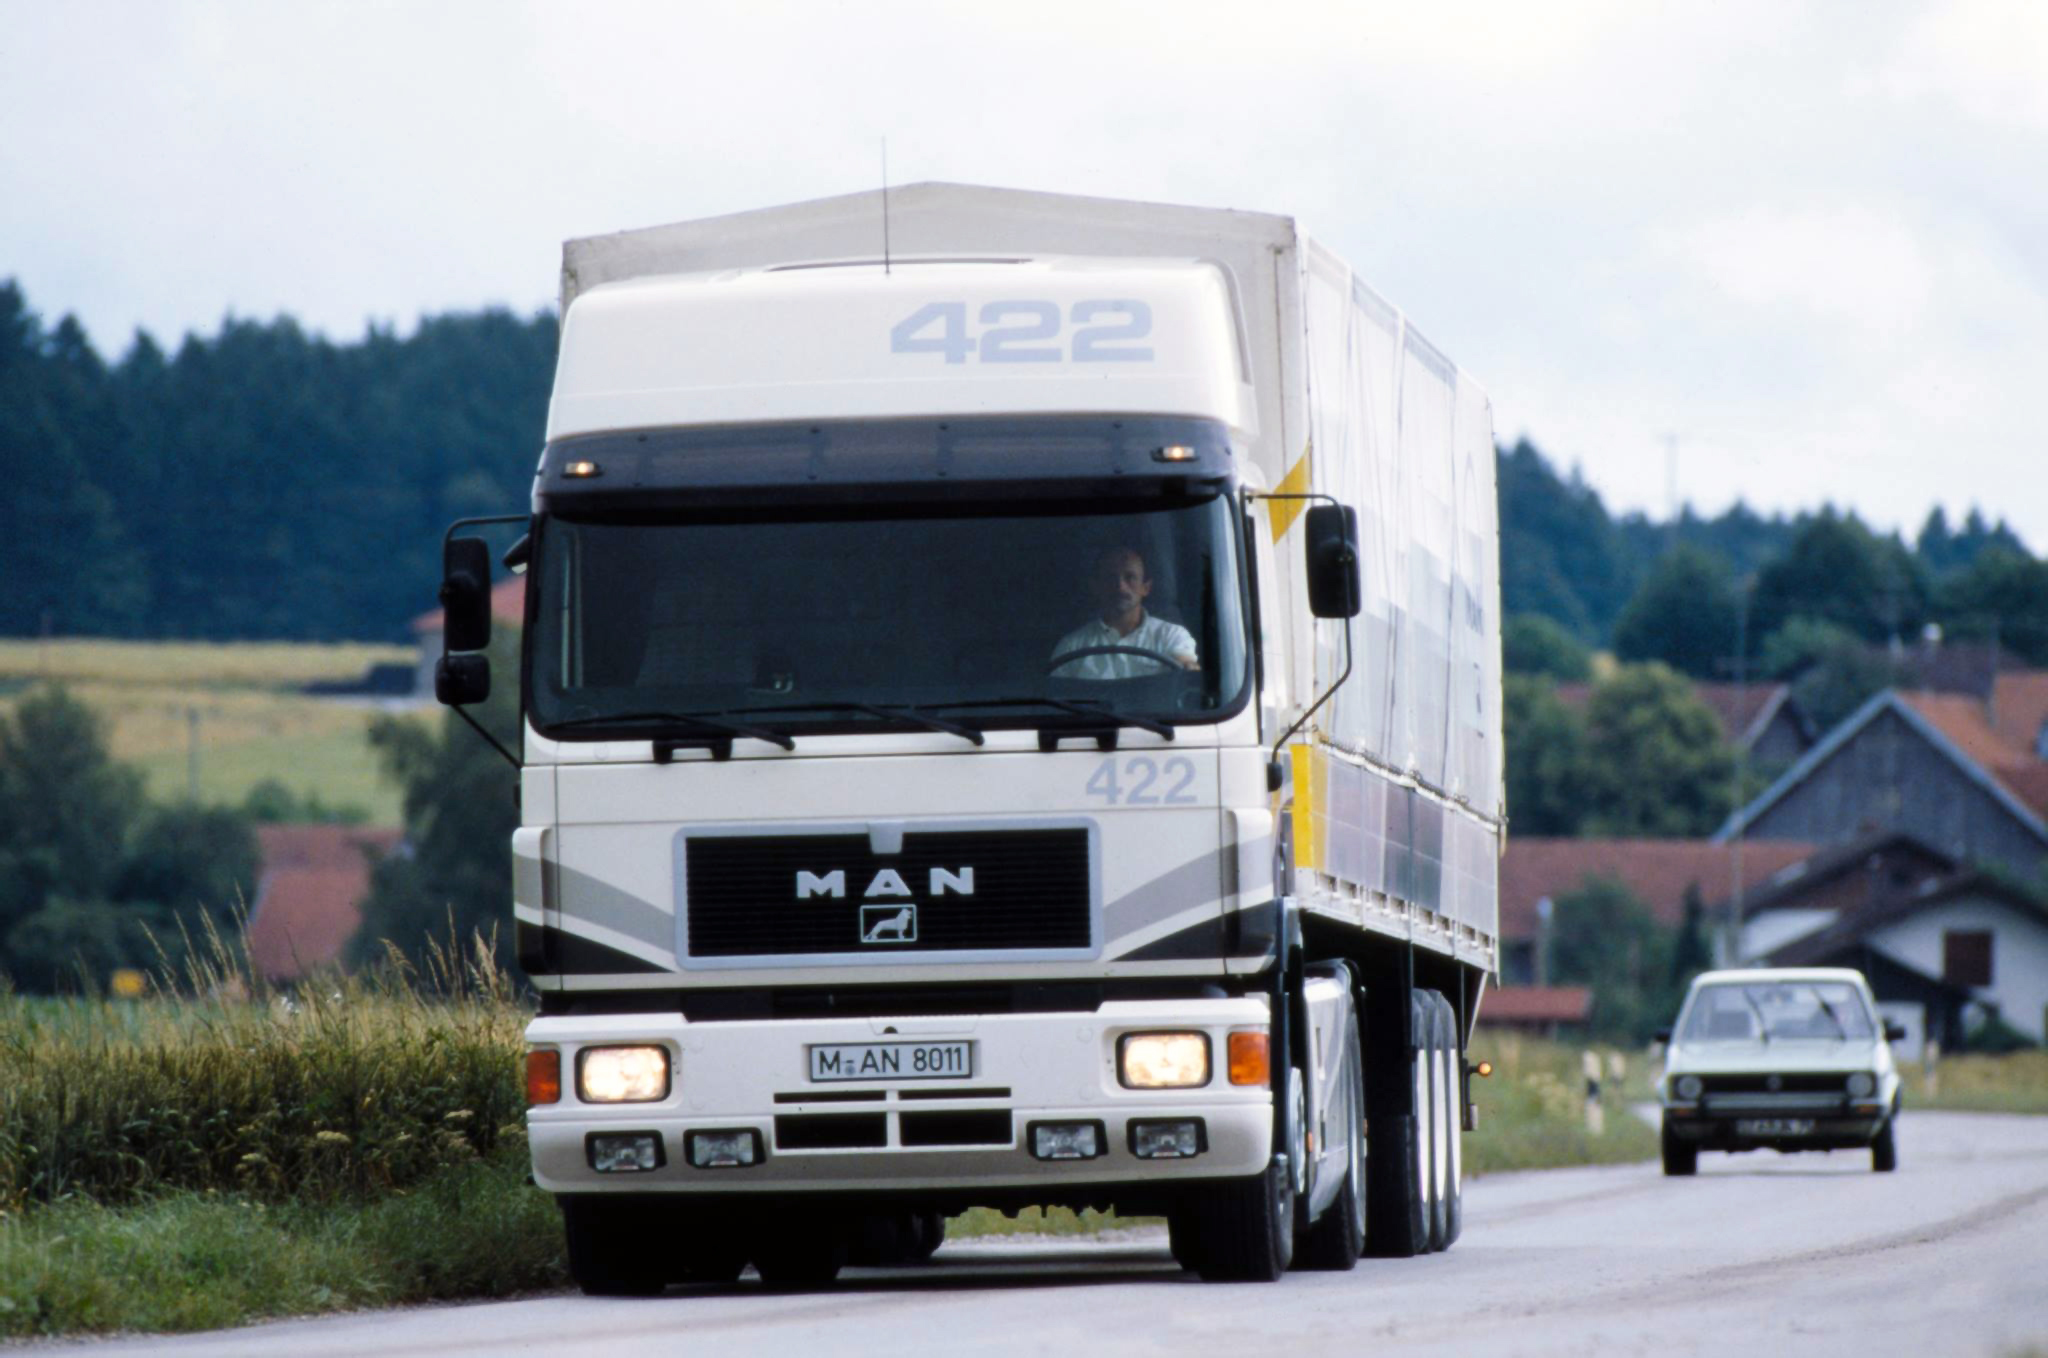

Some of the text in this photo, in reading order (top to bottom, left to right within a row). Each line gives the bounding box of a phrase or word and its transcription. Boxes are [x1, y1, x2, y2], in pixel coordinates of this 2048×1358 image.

[890, 299, 1154, 364] 422
[1086, 756, 1197, 804] 422
[797, 867, 974, 898] MAN
[913, 1047, 962, 1072] 8011
